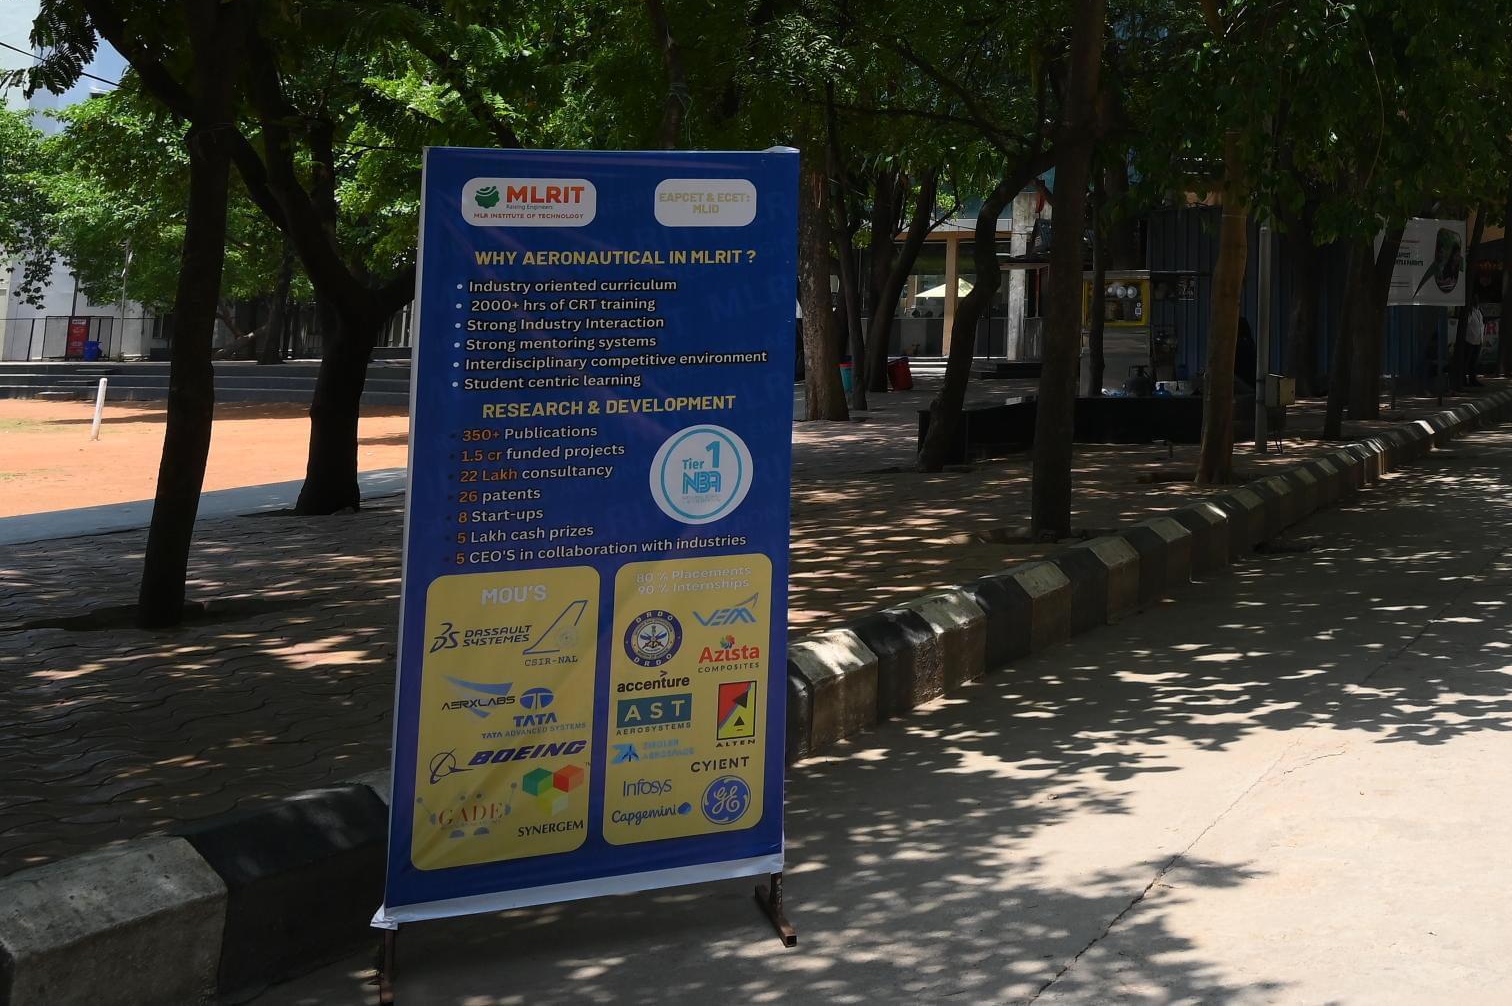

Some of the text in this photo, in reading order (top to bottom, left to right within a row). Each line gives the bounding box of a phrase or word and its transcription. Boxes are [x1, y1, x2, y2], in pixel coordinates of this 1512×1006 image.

[507, 185, 585, 203] MLRIT
[659, 193, 704, 202] EAPCET
[706, 193, 714, 202] &
[475, 250, 757, 265] WHY AERONAUTICAL IN MLRIT ?
[469, 280, 677, 295] Industry oriented curriculum
[471, 299, 656, 313] 2000+ hrs of CRT training
[467, 317, 664, 333] Strong Industry Interaction
[466, 337, 657, 352] Strong mentoring systems
[465, 351, 768, 370] Interdisciplinary competitive environment
[464, 374, 641, 390] Student centric learning
[482, 396, 737, 418] RESEARCH & DEVELOPMENT
[462, 425, 598, 442] 350+ Publications
[461, 450, 483, 462] 1.5
[506, 446, 561, 460] funded
[564, 444, 625, 460] projects
[682, 441, 720, 469] Tier 1
[460, 464, 613, 482] 22 Lakh consultancy
[458, 488, 541, 504] 26 patents
[458, 508, 544, 524] 8 Start-ups
[457, 525, 594, 544] 5 Lakh cash prizes
[456, 535, 747, 564] 5 CEO'S in collaboration with industries
[672, 566, 752, 579] Placements
[673, 579, 749, 593] Internships
[482, 585, 547, 605] MOU'S
[464, 625, 532, 638] DASSAULT
[524, 656, 578, 667] CSIR-NAL
[699, 644, 760, 664] Azista
[698, 662, 760, 674] COMPOSITES
[617, 676, 690, 693] accenture
[441, 696, 515, 711] AERXLABS
[624, 699, 685, 722] AST
[513, 712, 558, 728] TATA
[505, 726, 547, 737] ADVANCED
[550, 722, 586, 731] SYSTEMS
[616, 722, 691, 736] AEROSYSTEMS
[715, 739, 756, 748] ALTEN
[468, 740, 588, 766] BOEING
[691, 756, 750, 773] CYIENT
[623, 779, 672, 797] Infosys
[612, 804, 677, 825] Capgemini
[518, 820, 584, 838] SYNERGEM
